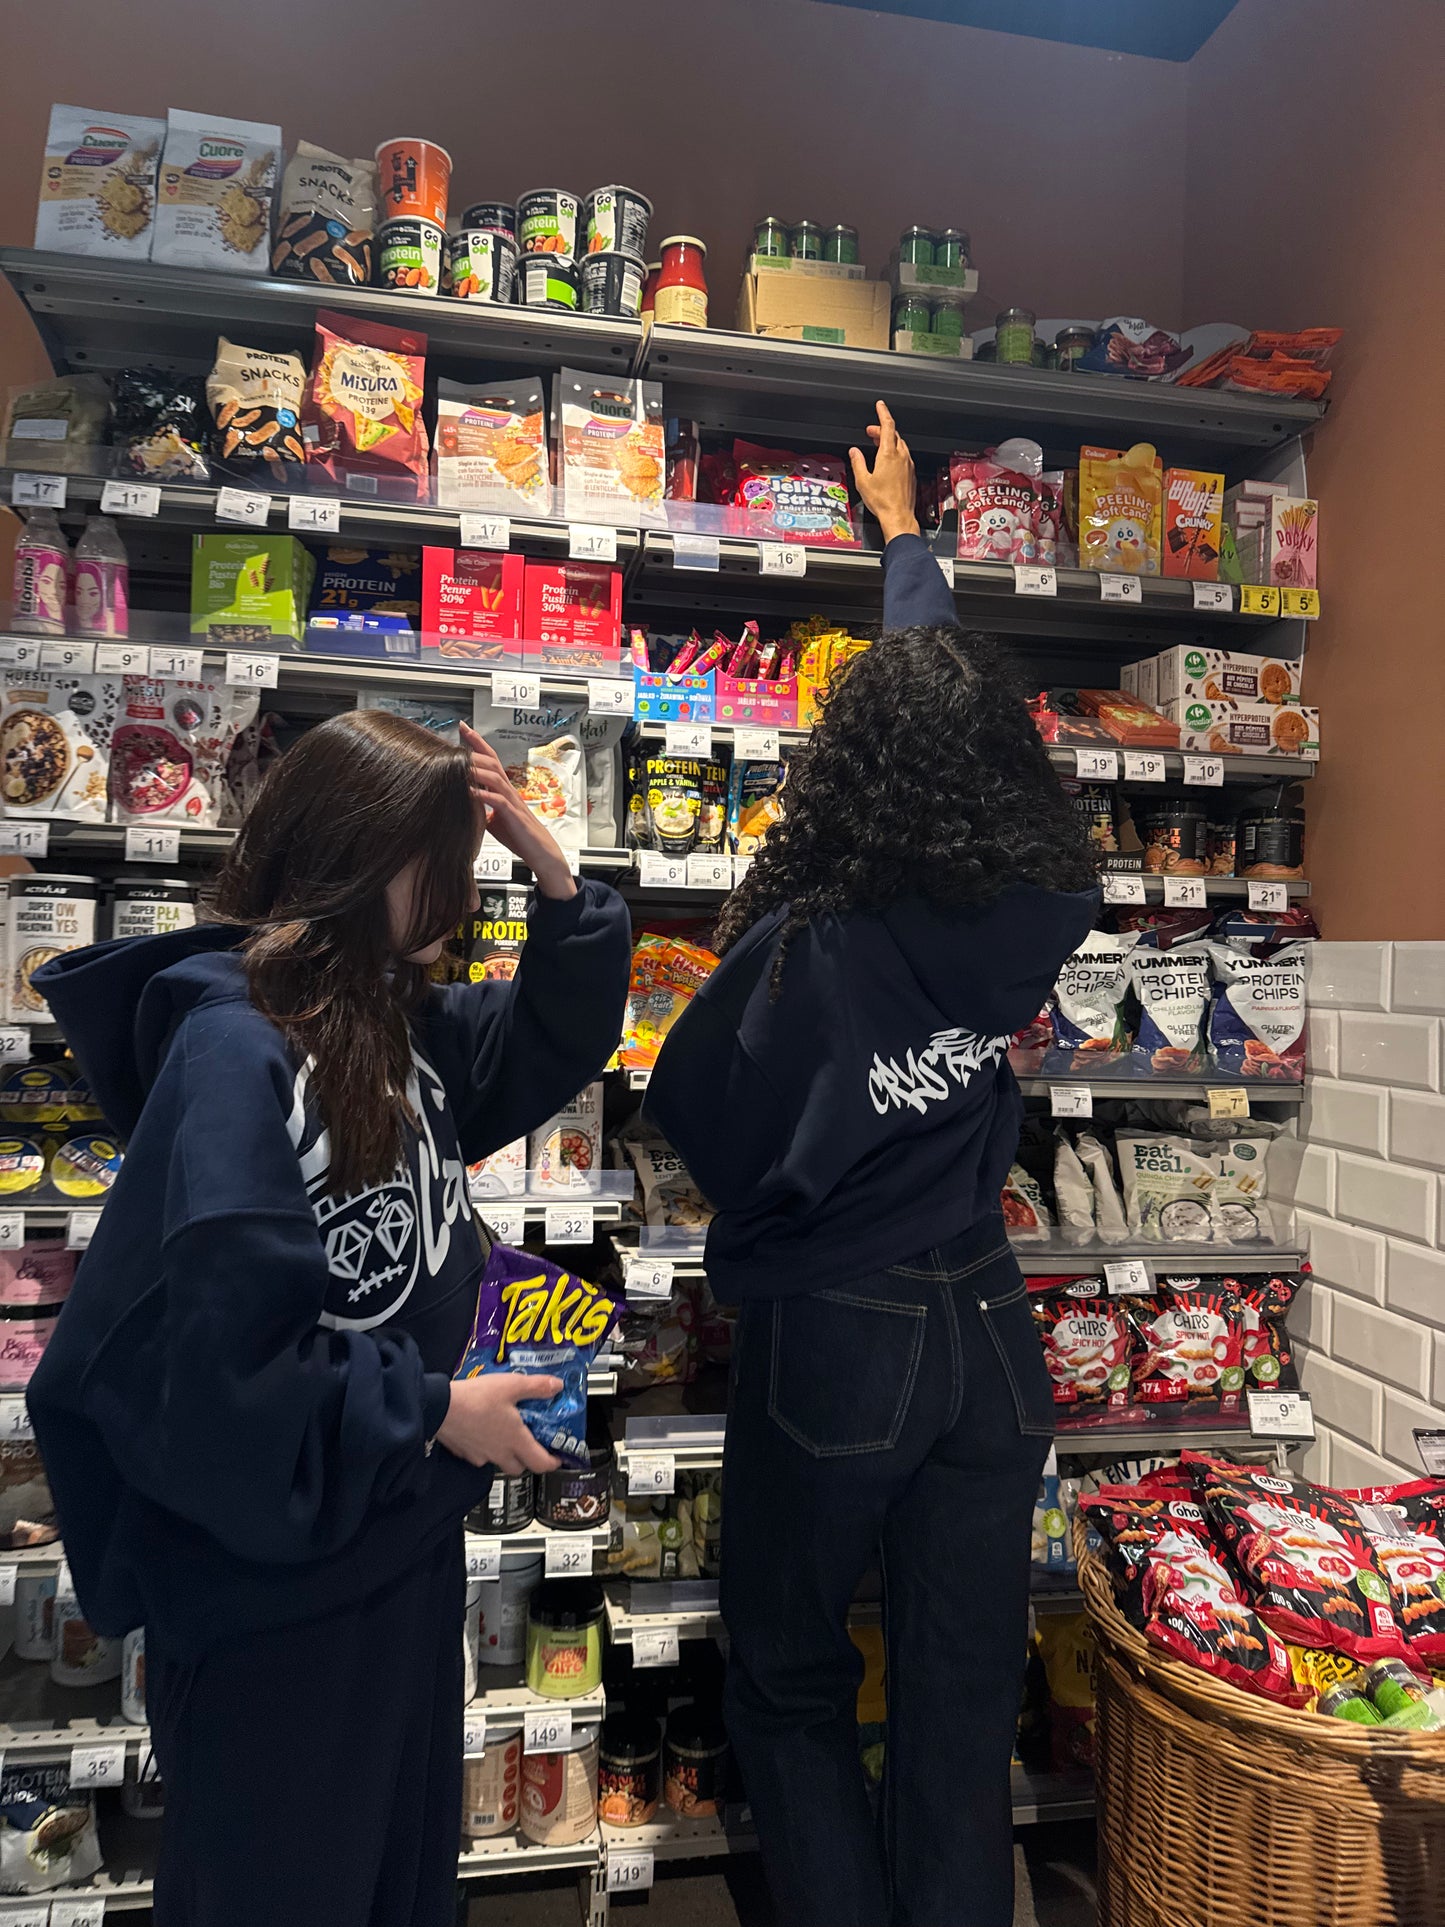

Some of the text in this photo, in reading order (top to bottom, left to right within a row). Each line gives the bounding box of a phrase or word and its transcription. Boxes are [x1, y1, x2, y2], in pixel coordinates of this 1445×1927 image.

[83, 134, 129, 149] Cuore
[199, 141, 244, 158] Cuore
[299, 176, 355, 207] SNACKS
[246, 352, 290, 366] PROTEIN
[240, 367, 300, 388] SNACKS
[348, 394, 390, 406] PROTEINE
[361, 405, 376, 415] 13g
[591, 400, 632, 418] Cuore
[464, 417, 495, 429] PROTEINE
[587, 429, 617, 440] PROTEINE
[770, 479, 823, 496] Jelly
[966, 486, 1032, 501] PEELING
[776, 493, 848, 513] Straws
[966, 496, 1032, 514] Soft Candy
[1096, 493, 1153, 514] PEELING
[1094, 505, 1151, 525] Soft Candy
[1175, 513, 1215, 531] CRUNKY
[208, 560, 247, 571] Protein
[208, 570, 238, 580] Pasta
[439, 573, 479, 587] Protein
[208, 579, 225, 589] Bio
[322, 577, 397, 593] PROTEIN
[439, 584, 472, 596] Penne
[541, 583, 579, 597] Protein
[541, 593, 573, 605] Fusilli
[1222, 662, 1259, 675] HYPERPROTEIN
[5, 671, 52, 683] MUESLI
[123, 675, 165, 686] SUPER
[126, 685, 165, 698] MUESLI
[512, 707, 579, 729] Breakfast
[1229, 712, 1271, 724] HYPERPROTEIN
[646, 759, 701, 776] PROTEIN
[649, 778, 668, 788] APPLE
[1107, 858, 1142, 870] PROTEIN
[508, 896, 527, 905] ONE
[28, 901, 77, 917] SUPER OW
[130, 904, 180, 922] SUPER PŁA
[508, 904, 526, 912] DAY
[508, 910, 527, 919] MOR
[56, 919, 79, 934] YES
[1132, 955, 1211, 971] YUMMER'S
[1224, 956, 1306, 971] YUMMER'S
[1238, 973, 1305, 987] PROTEIN
[1066, 981, 1116, 996] CHIPS
[1150, 986, 1205, 1002] CHIPS
[1252, 987, 1300, 1001] CHIPS
[578, 1101, 595, 1114] YES
[1133, 1143, 1174, 1159] Eat
[1136, 1172, 1163, 1181] QUINOA
[1150, 1290, 1225, 1318] LENTIL
[496, 1273, 614, 1363] Takis
[1044, 1298, 1115, 1325] LENTI
[1173, 1312, 1210, 1330] CHIPS
[1068, 1320, 1108, 1337] CHIPS
[1175, 1330, 1210, 1341] SPICY HOT
[1071, 1337, 1106, 1348] SPICY HOT
[533, 1353, 555, 1362] HEAT
[1141, 1382, 1161, 1394] 17%
[1268, 1508, 1316, 1531] CHIPS
[1367, 1534, 1389, 1547] SPICY
[1268, 1590, 1286, 1607] 100
